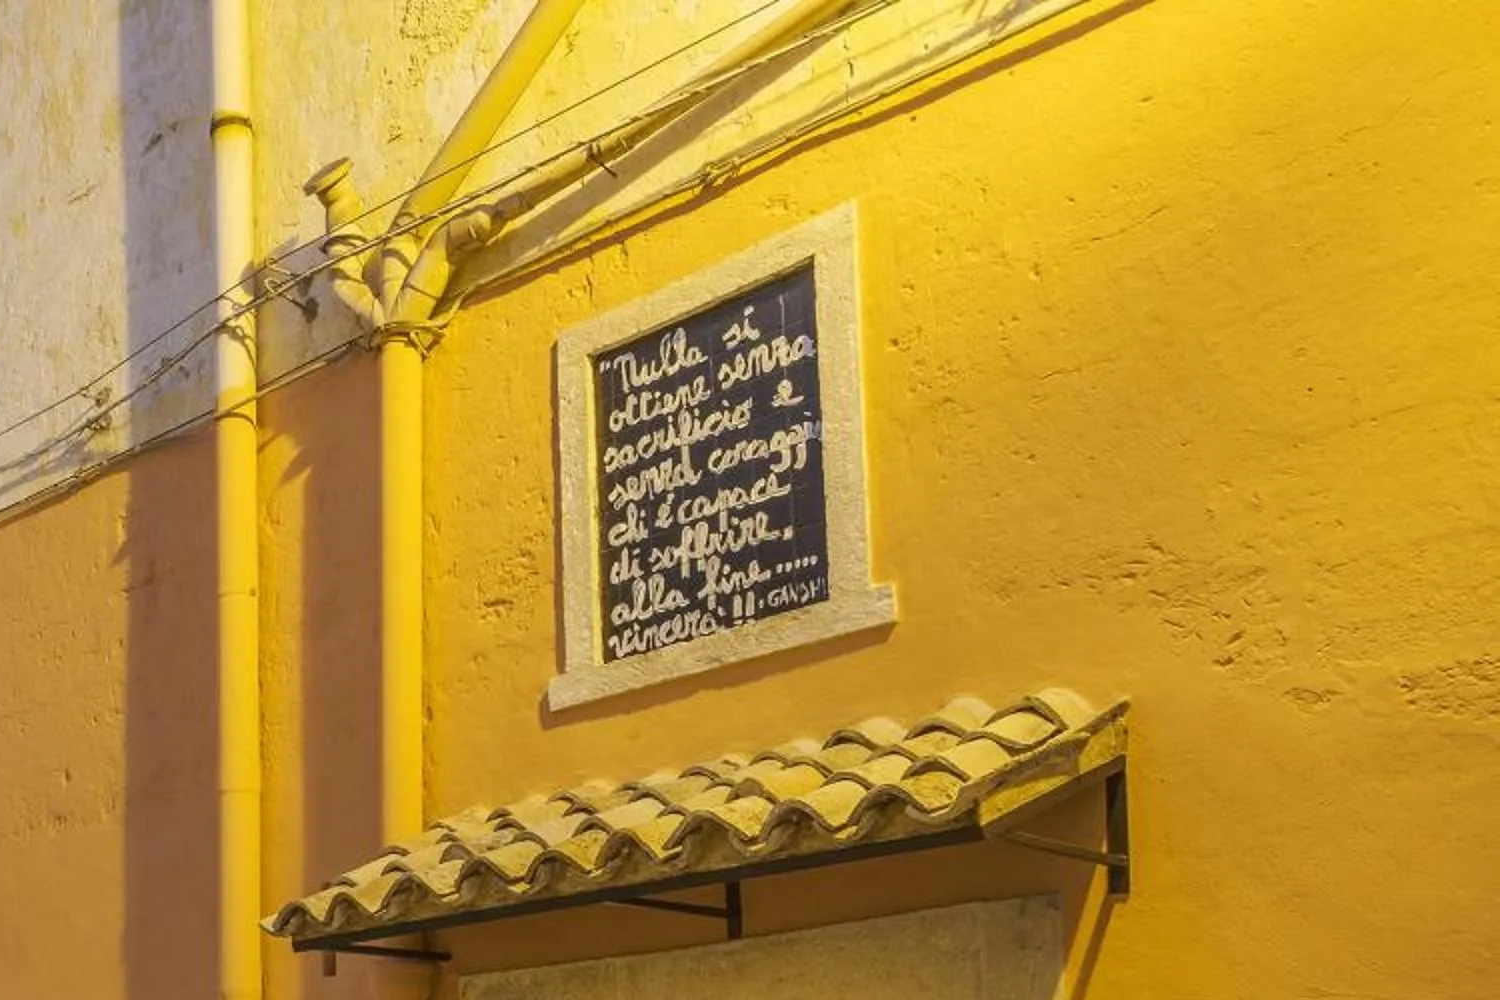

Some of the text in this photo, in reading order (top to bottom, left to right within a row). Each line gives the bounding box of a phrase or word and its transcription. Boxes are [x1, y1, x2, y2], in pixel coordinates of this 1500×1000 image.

[722, 305, 760, 350] si
[609, 335, 816, 432] ottiene senza
[604, 397, 753, 478] sacrificio
[608, 458, 702, 511] senza
[678, 474, 791, 533] capace
[610, 547, 644, 585] di
[611, 573, 690, 626] alla
